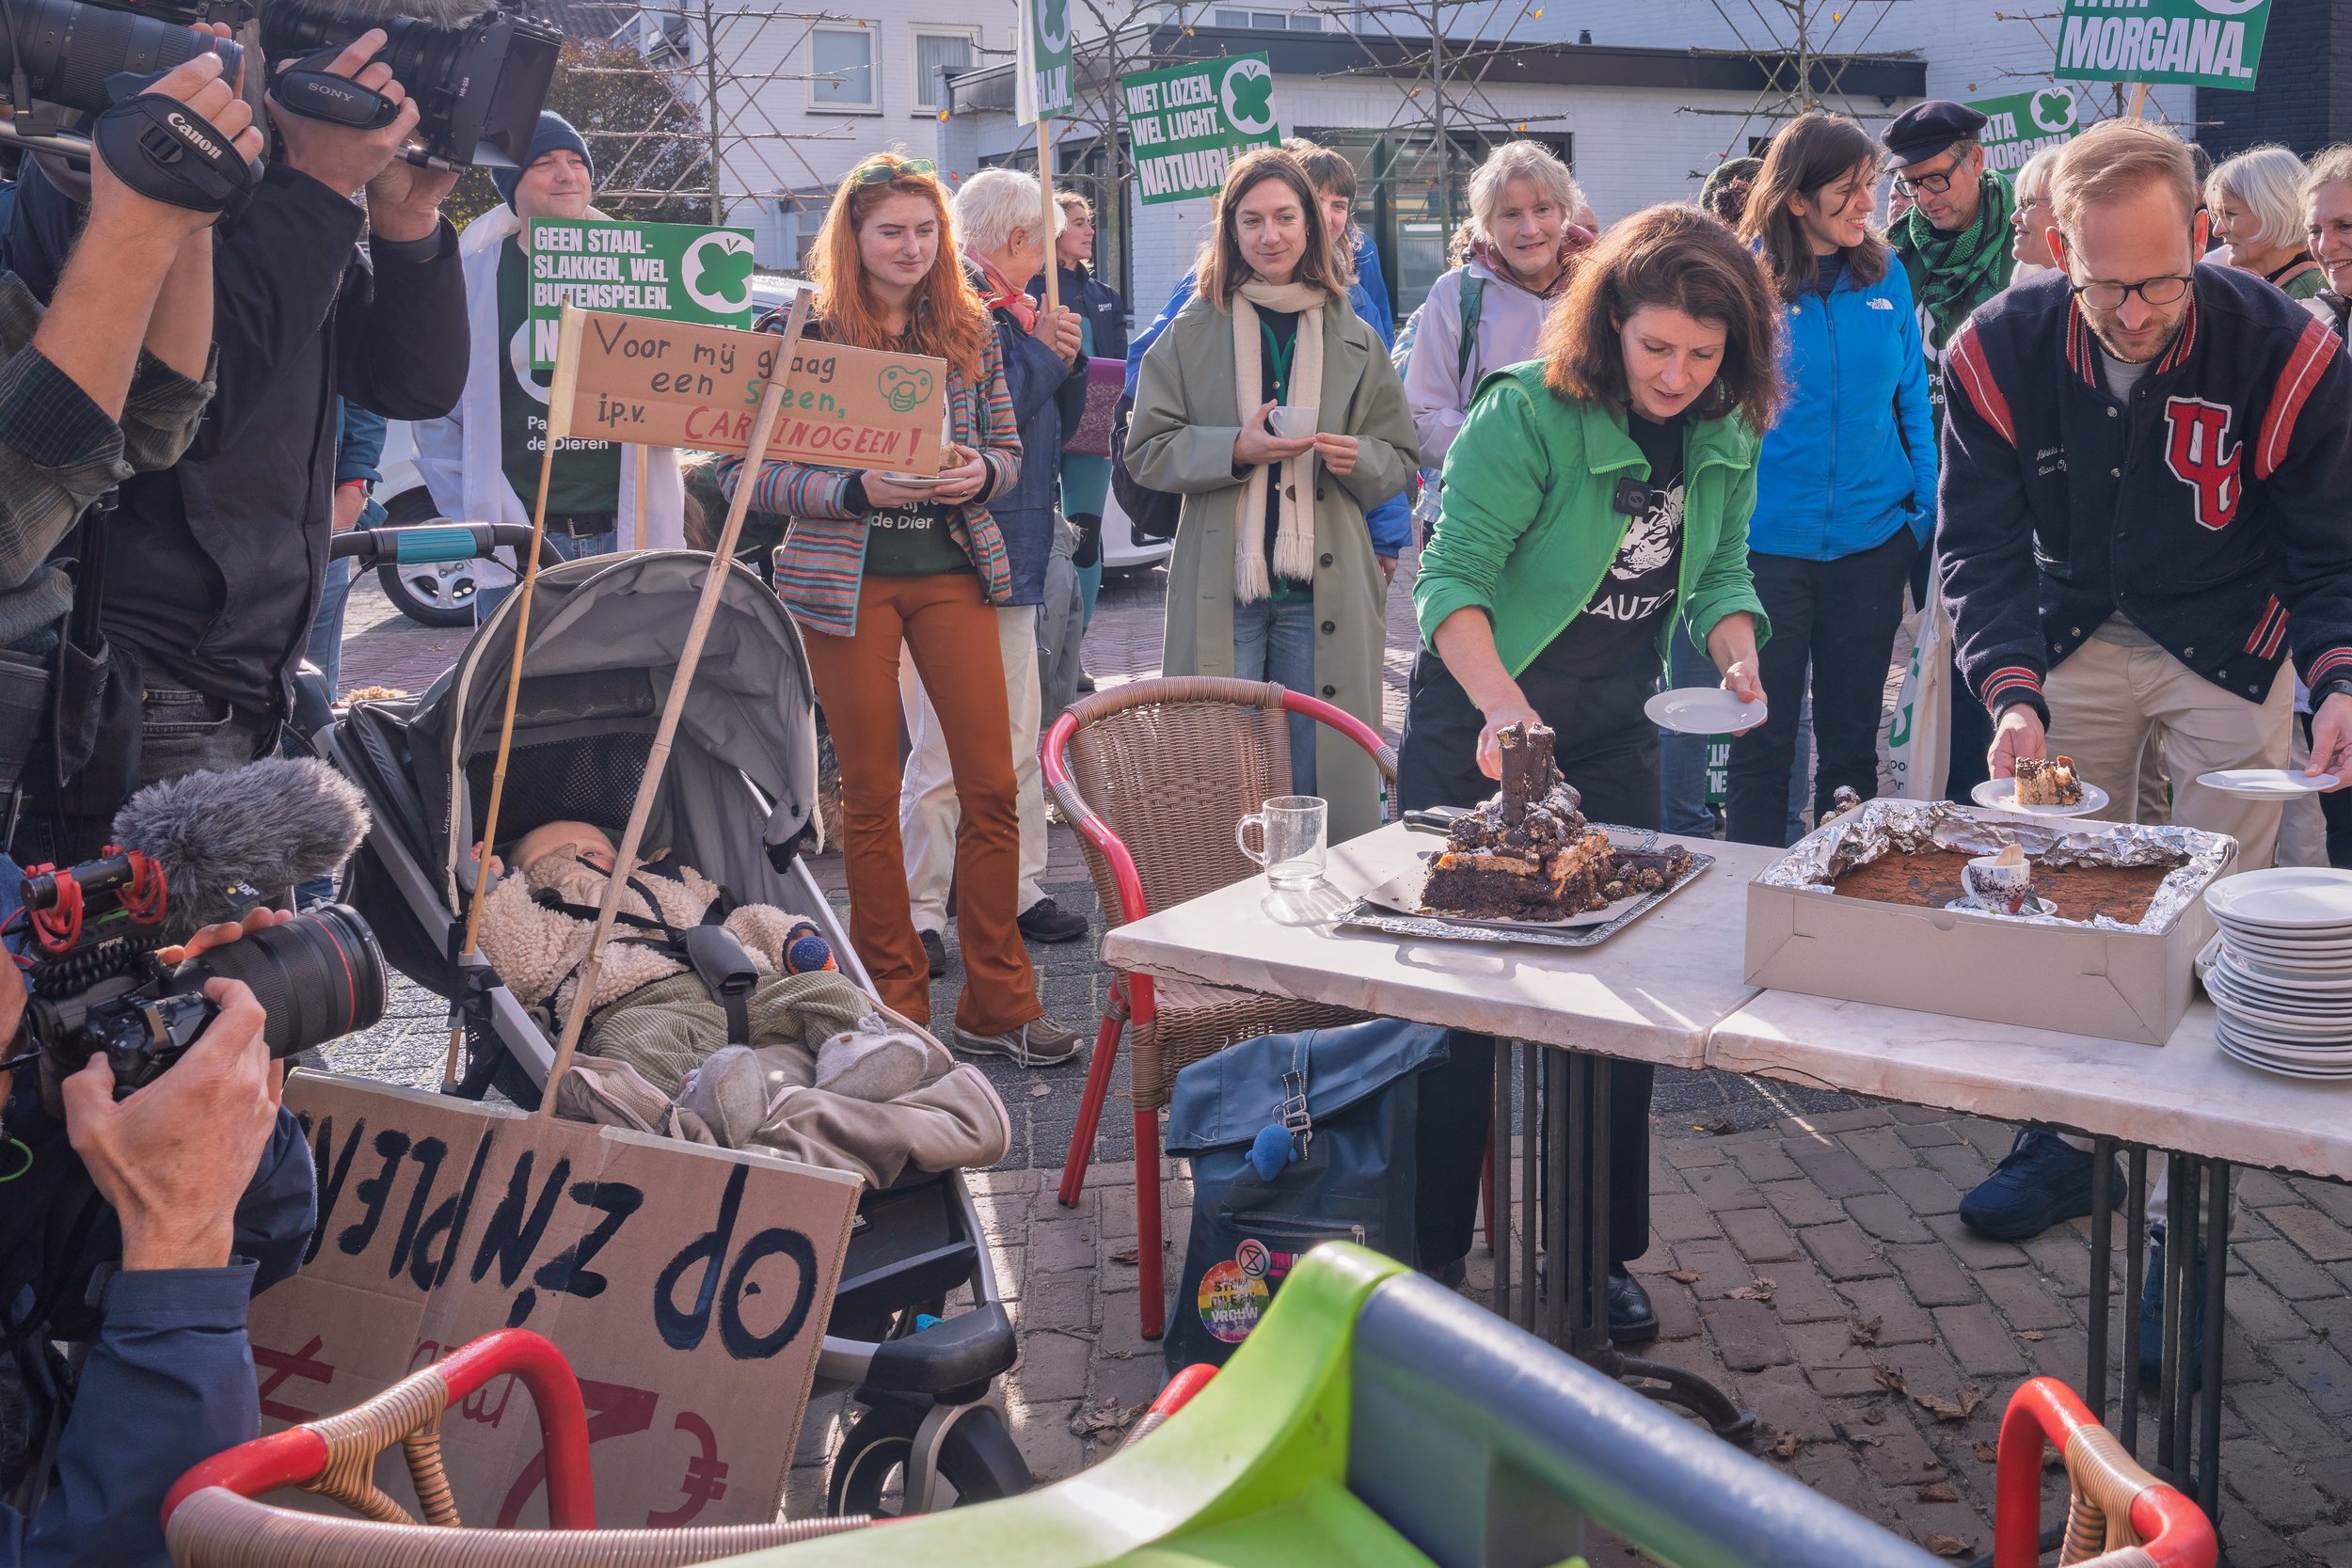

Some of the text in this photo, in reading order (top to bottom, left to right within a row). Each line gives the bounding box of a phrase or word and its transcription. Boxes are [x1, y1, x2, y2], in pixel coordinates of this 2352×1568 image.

[2059, 15, 2253, 78] MORGANA.
[308, 82, 355, 102] SONY
[1126, 74, 1218, 115] NIET LOZEN,
[167, 112, 223, 160] Canon
[1131, 106, 1225, 147] WEL LUCHT.
[1980, 112, 2018, 143] ATA
[534, 227, 654, 254] GEEN STAAL-
[533, 255, 669, 284] SLAKKEN, WEL
[593, 318, 672, 358] Voor
[757, 349, 836, 384] gaag
[650, 368, 846, 420] een Seen,
[527, 436, 546, 451] de
[683, 405, 923, 467] CARINOGEEN!
[871, 512, 894, 529] de
